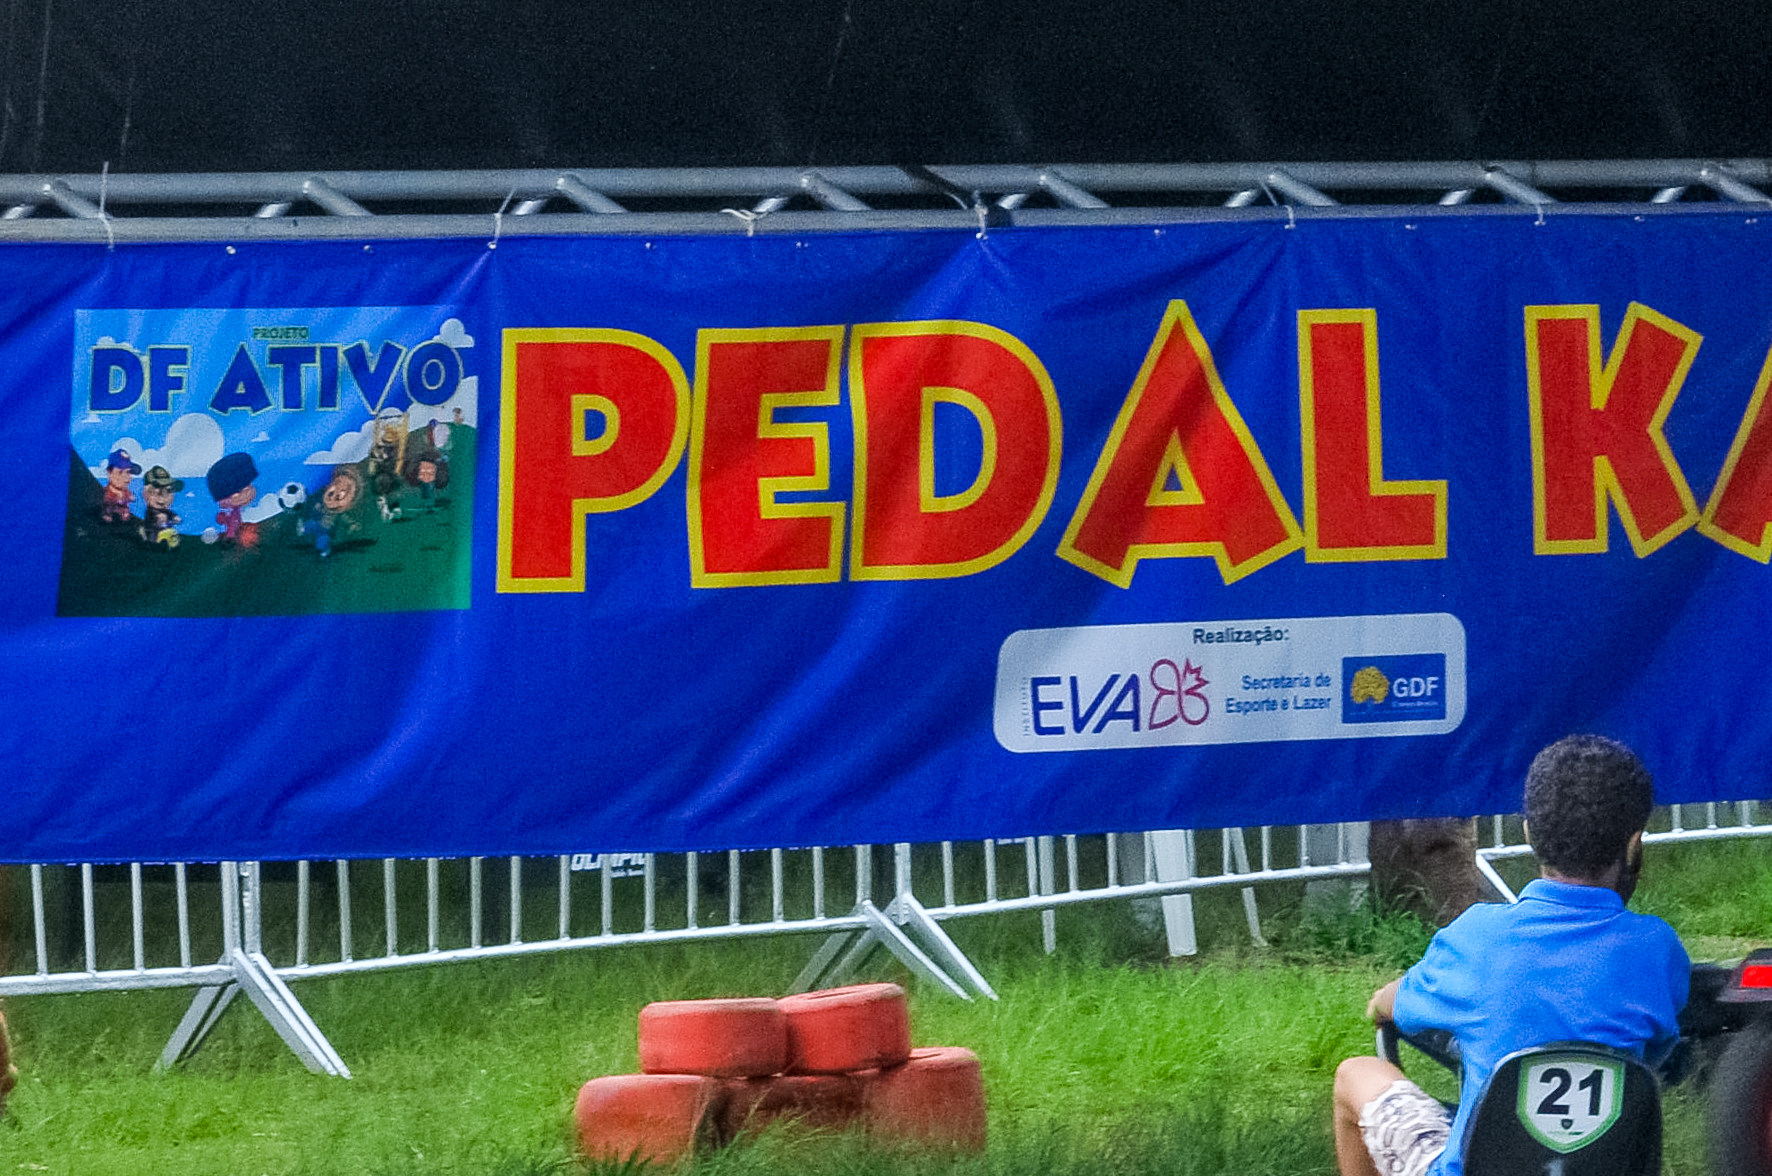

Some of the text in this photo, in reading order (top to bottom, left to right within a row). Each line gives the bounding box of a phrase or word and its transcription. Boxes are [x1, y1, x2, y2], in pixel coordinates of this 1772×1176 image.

[253, 326, 310, 340] PROJETO
[86, 339, 465, 417] DF ATIVO
[496, 298, 1448, 593] PEDAL
[1193, 625, 1290, 646] Realização:
[1241, 672, 1332, 691] Secretaria de
[1392, 676, 1439, 698] GDF
[1030, 673, 1141, 736] EVA
[1225, 695, 1332, 716] Esporte e Lazer
[1536, 1067, 1604, 1116] 21
